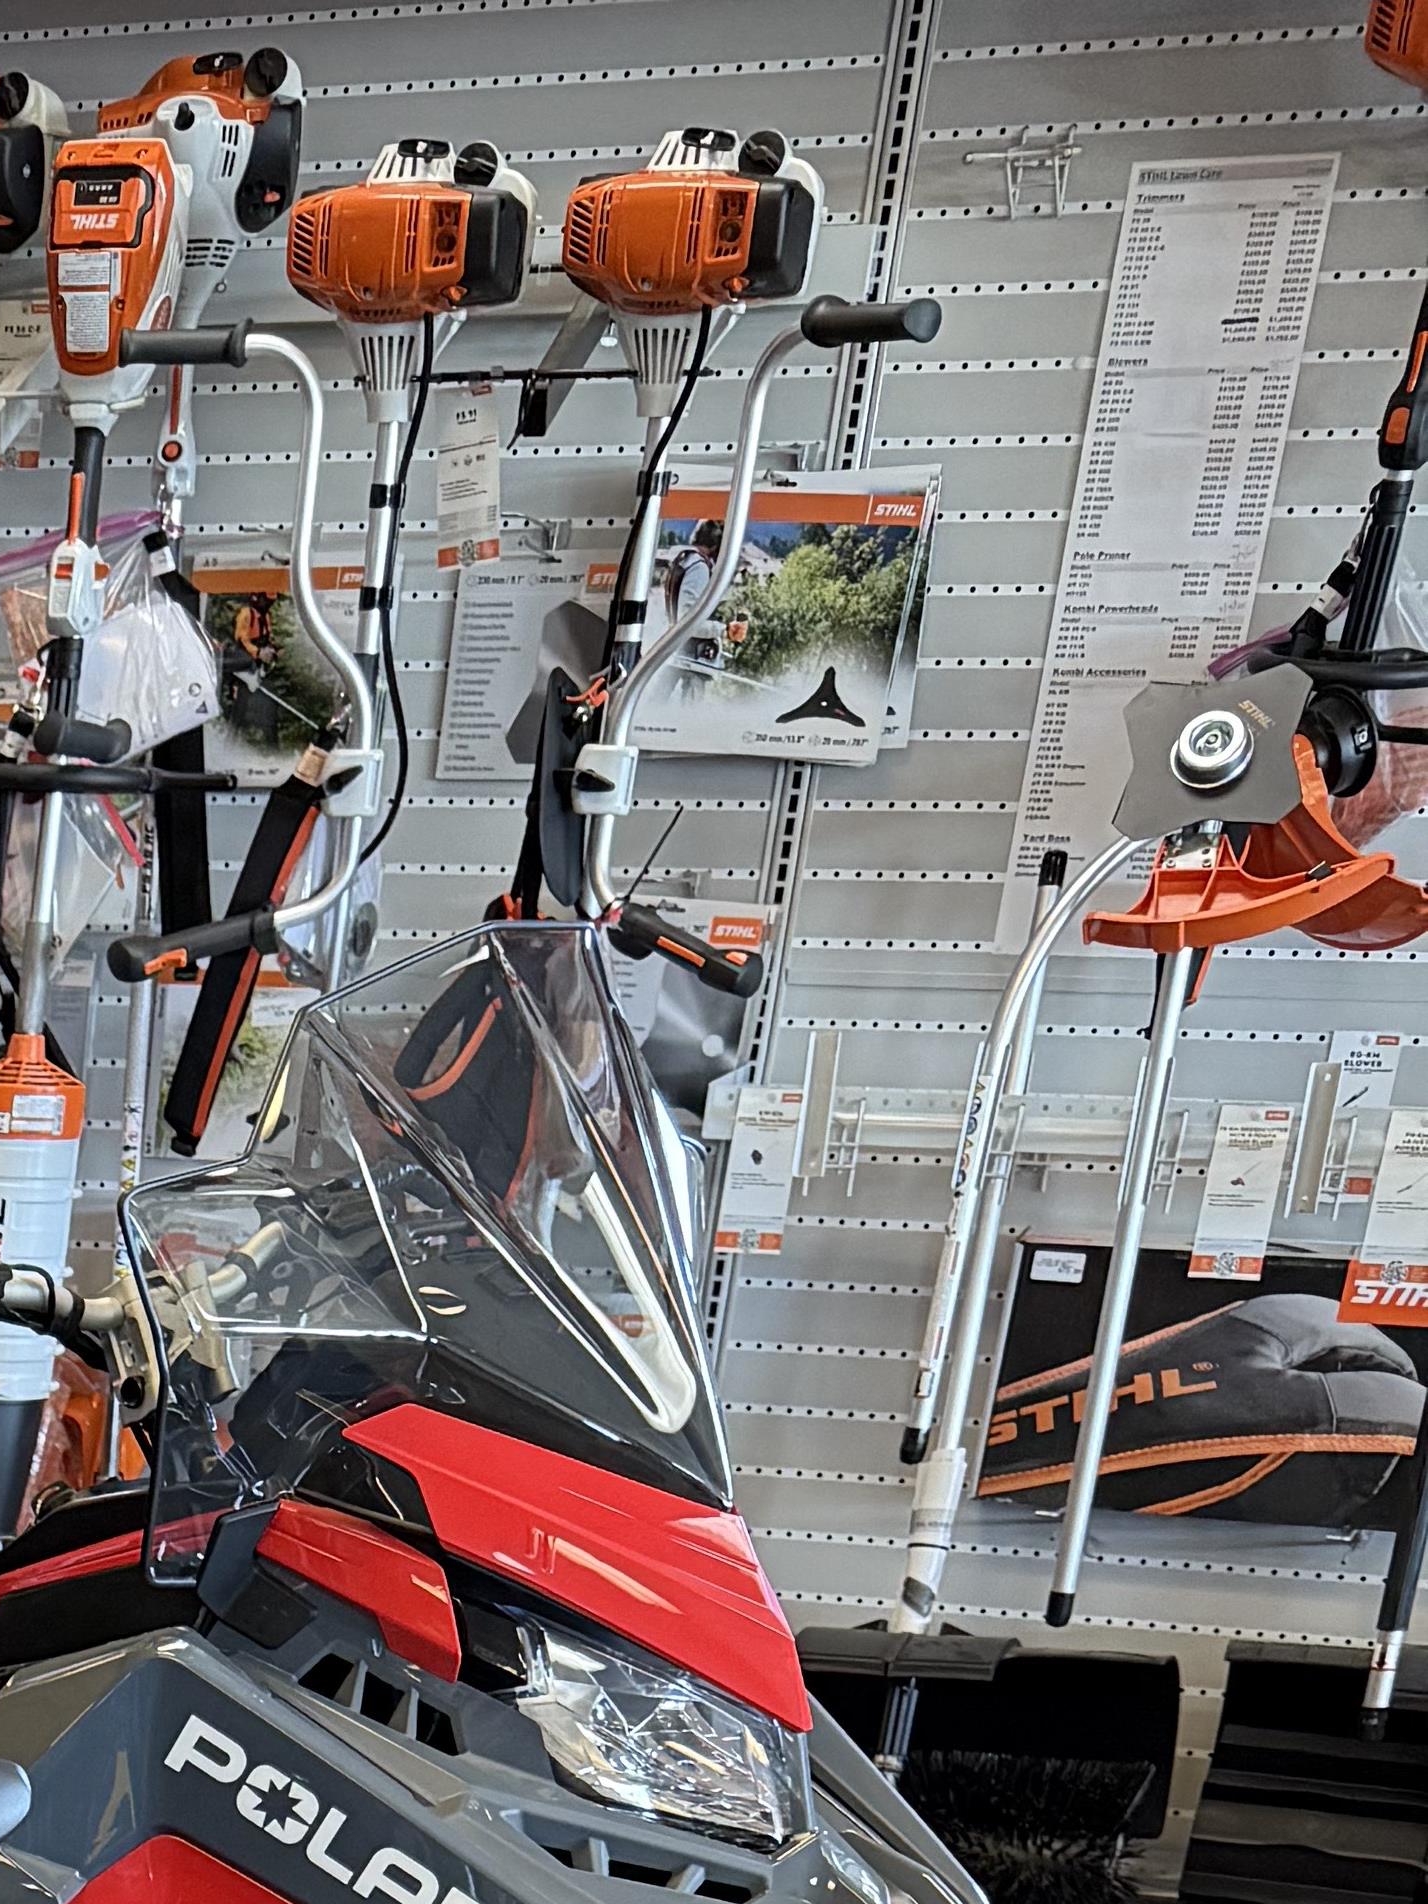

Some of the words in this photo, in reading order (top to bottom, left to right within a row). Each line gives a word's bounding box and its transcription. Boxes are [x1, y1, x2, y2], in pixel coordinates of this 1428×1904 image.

[1137, 193, 1186, 204] Trimmers
[70, 213, 120, 230] STIHL
[874, 502, 918, 517] STIHL
[1073, 551, 1096, 561] Pole
[1097, 551, 1132, 561] Pruner
[1064, 604, 1096, 614] Kombi
[1098, 604, 1159, 614] Powerheads
[1052, 668, 1084, 677] Kombi
[1086, 668, 1147, 678] Accessories
[1238, 699, 1273, 729] STIHL
[713, 924, 757, 939] STIHL
[1344, 1059, 1382, 1068] BLOWER
[987, 1368, 1218, 1447] STIHL
